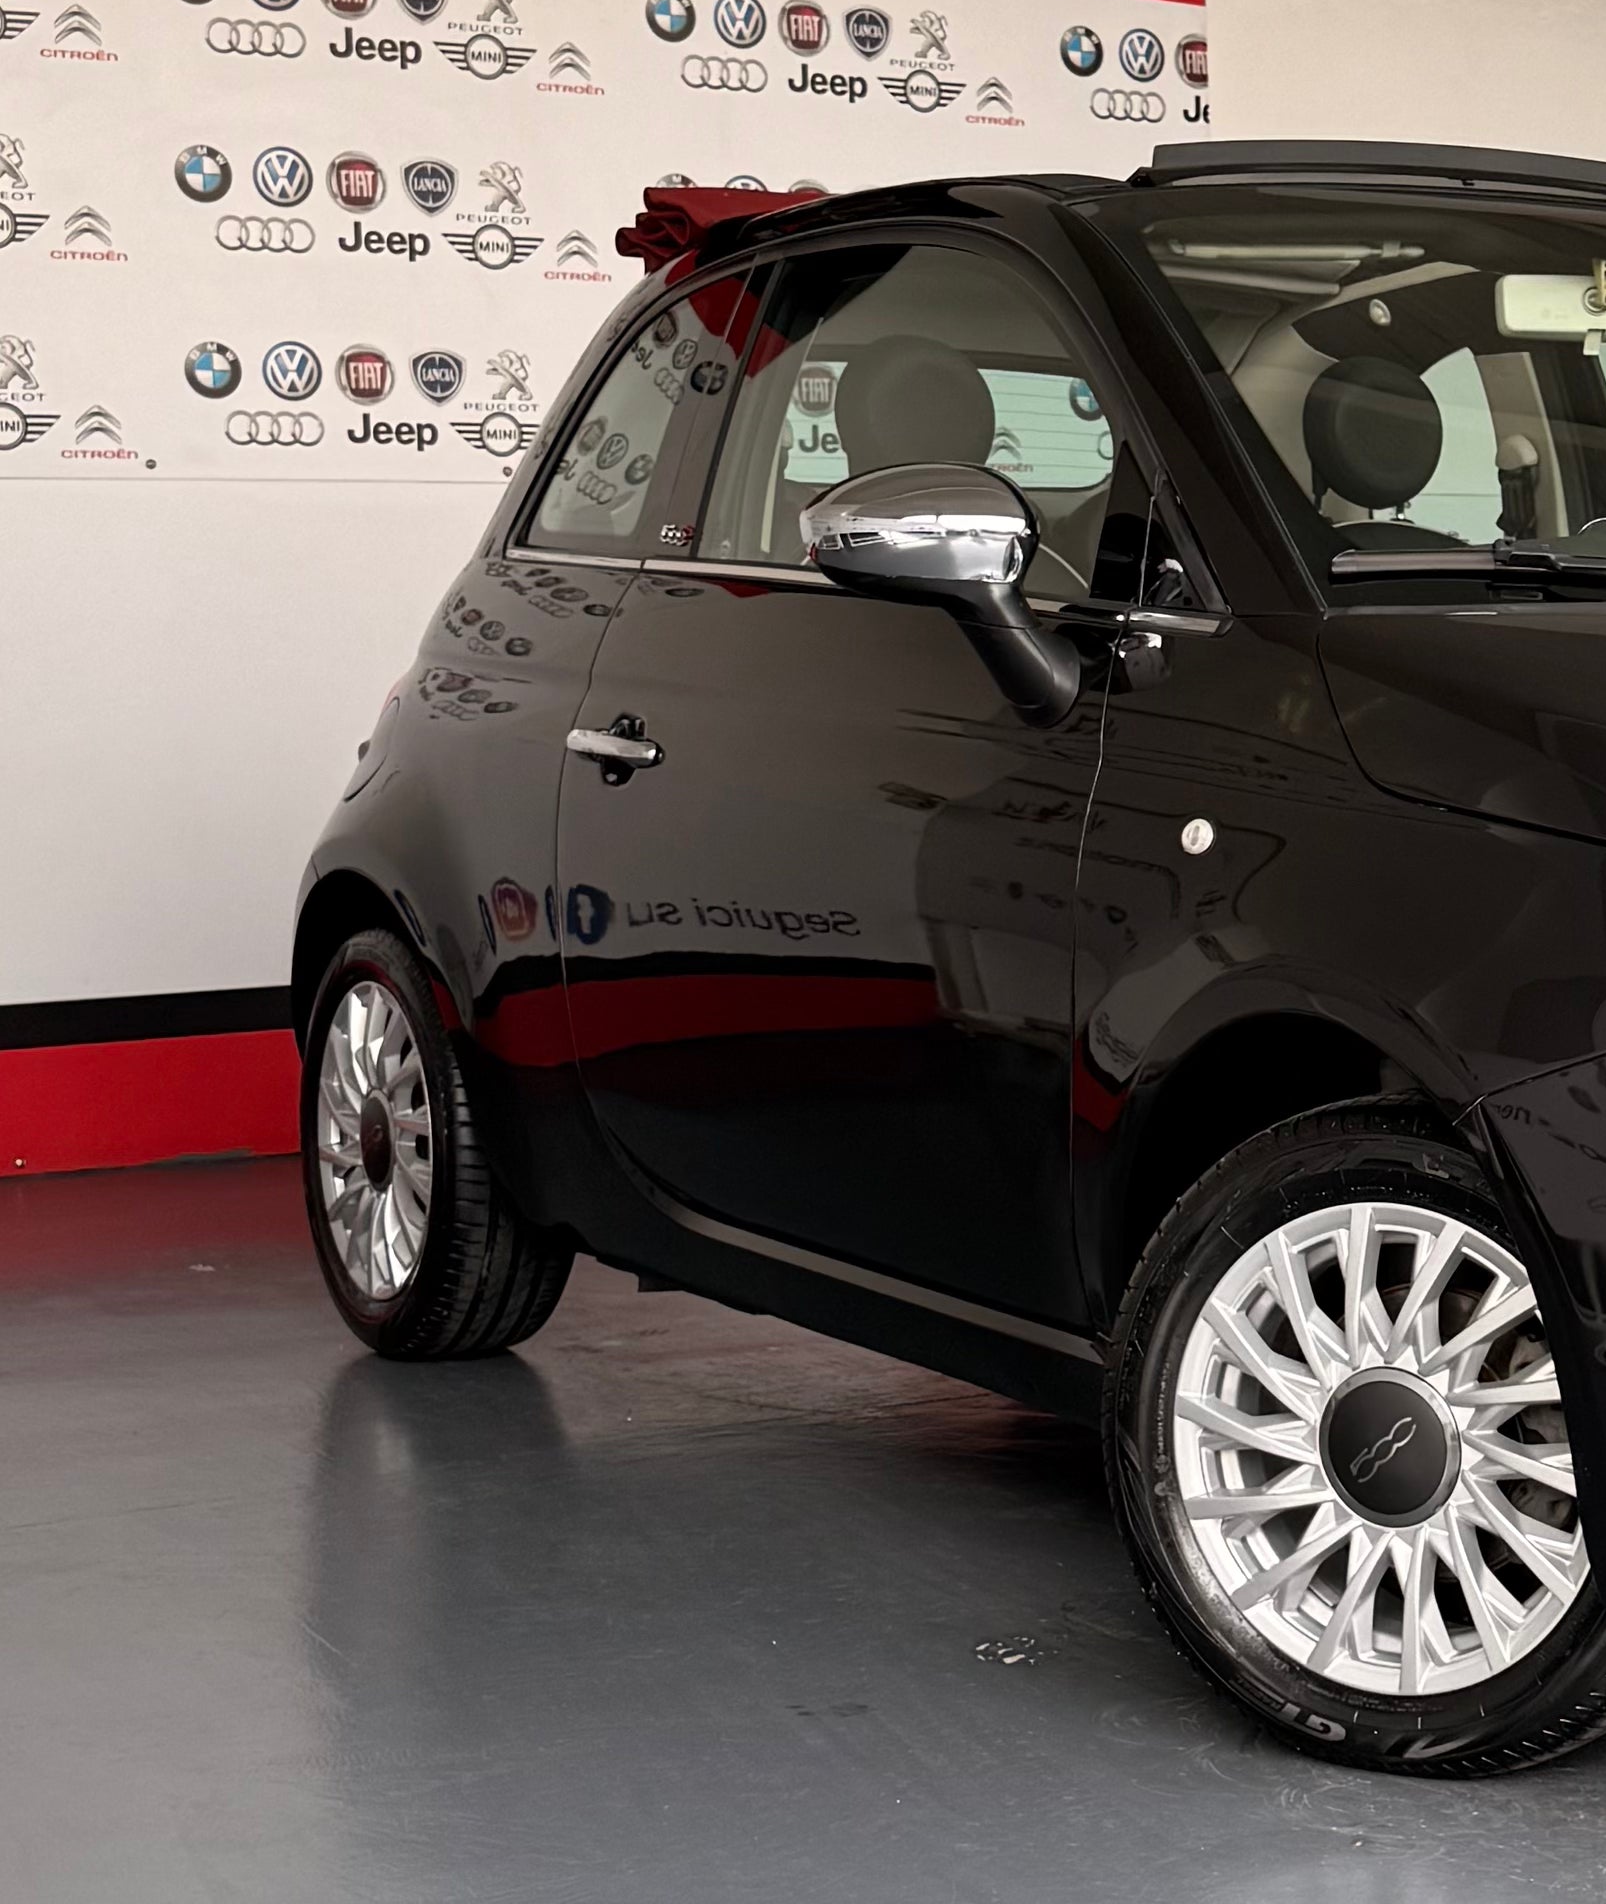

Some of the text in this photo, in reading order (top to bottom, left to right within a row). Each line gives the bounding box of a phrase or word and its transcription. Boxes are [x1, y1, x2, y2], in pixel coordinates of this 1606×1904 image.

[447, 22, 525, 36] PEUGEOT
[789, 14, 820, 42] FIAT
[329, 26, 423, 70] Jeep
[471, 50, 502, 63] MINI
[788, 63, 869, 104] Jeep
[910, 86, 938, 98] MINI
[340, 169, 375, 198] FIAT
[413, 176, 448, 194] LANCIA
[455, 213, 532, 226] PEUGEOT
[338, 221, 431, 263] Jeep
[479, 241, 510, 253] MINI
[349, 362, 384, 390] FIAT
[422, 366, 455, 384] LANCIA
[801, 378, 831, 403] FIAT
[463, 401, 541, 413] PEUGEOT
[347, 413, 440, 452] Jeep
[486, 428, 518, 442] MINI
[798, 424, 840, 454] Je
